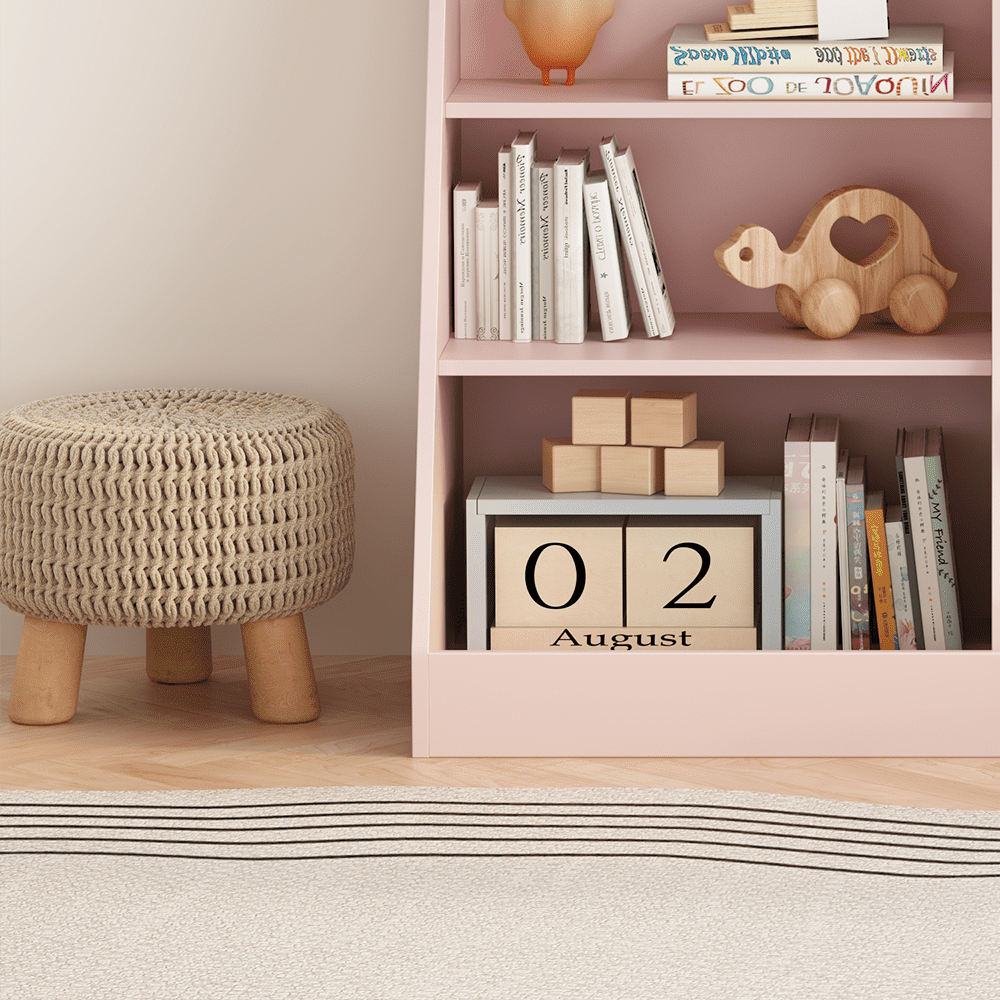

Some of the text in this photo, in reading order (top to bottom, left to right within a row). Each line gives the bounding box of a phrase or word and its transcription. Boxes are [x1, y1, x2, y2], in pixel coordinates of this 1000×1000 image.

[930, 501, 949, 566] MY Friend
[549, 628, 692, 651] August
